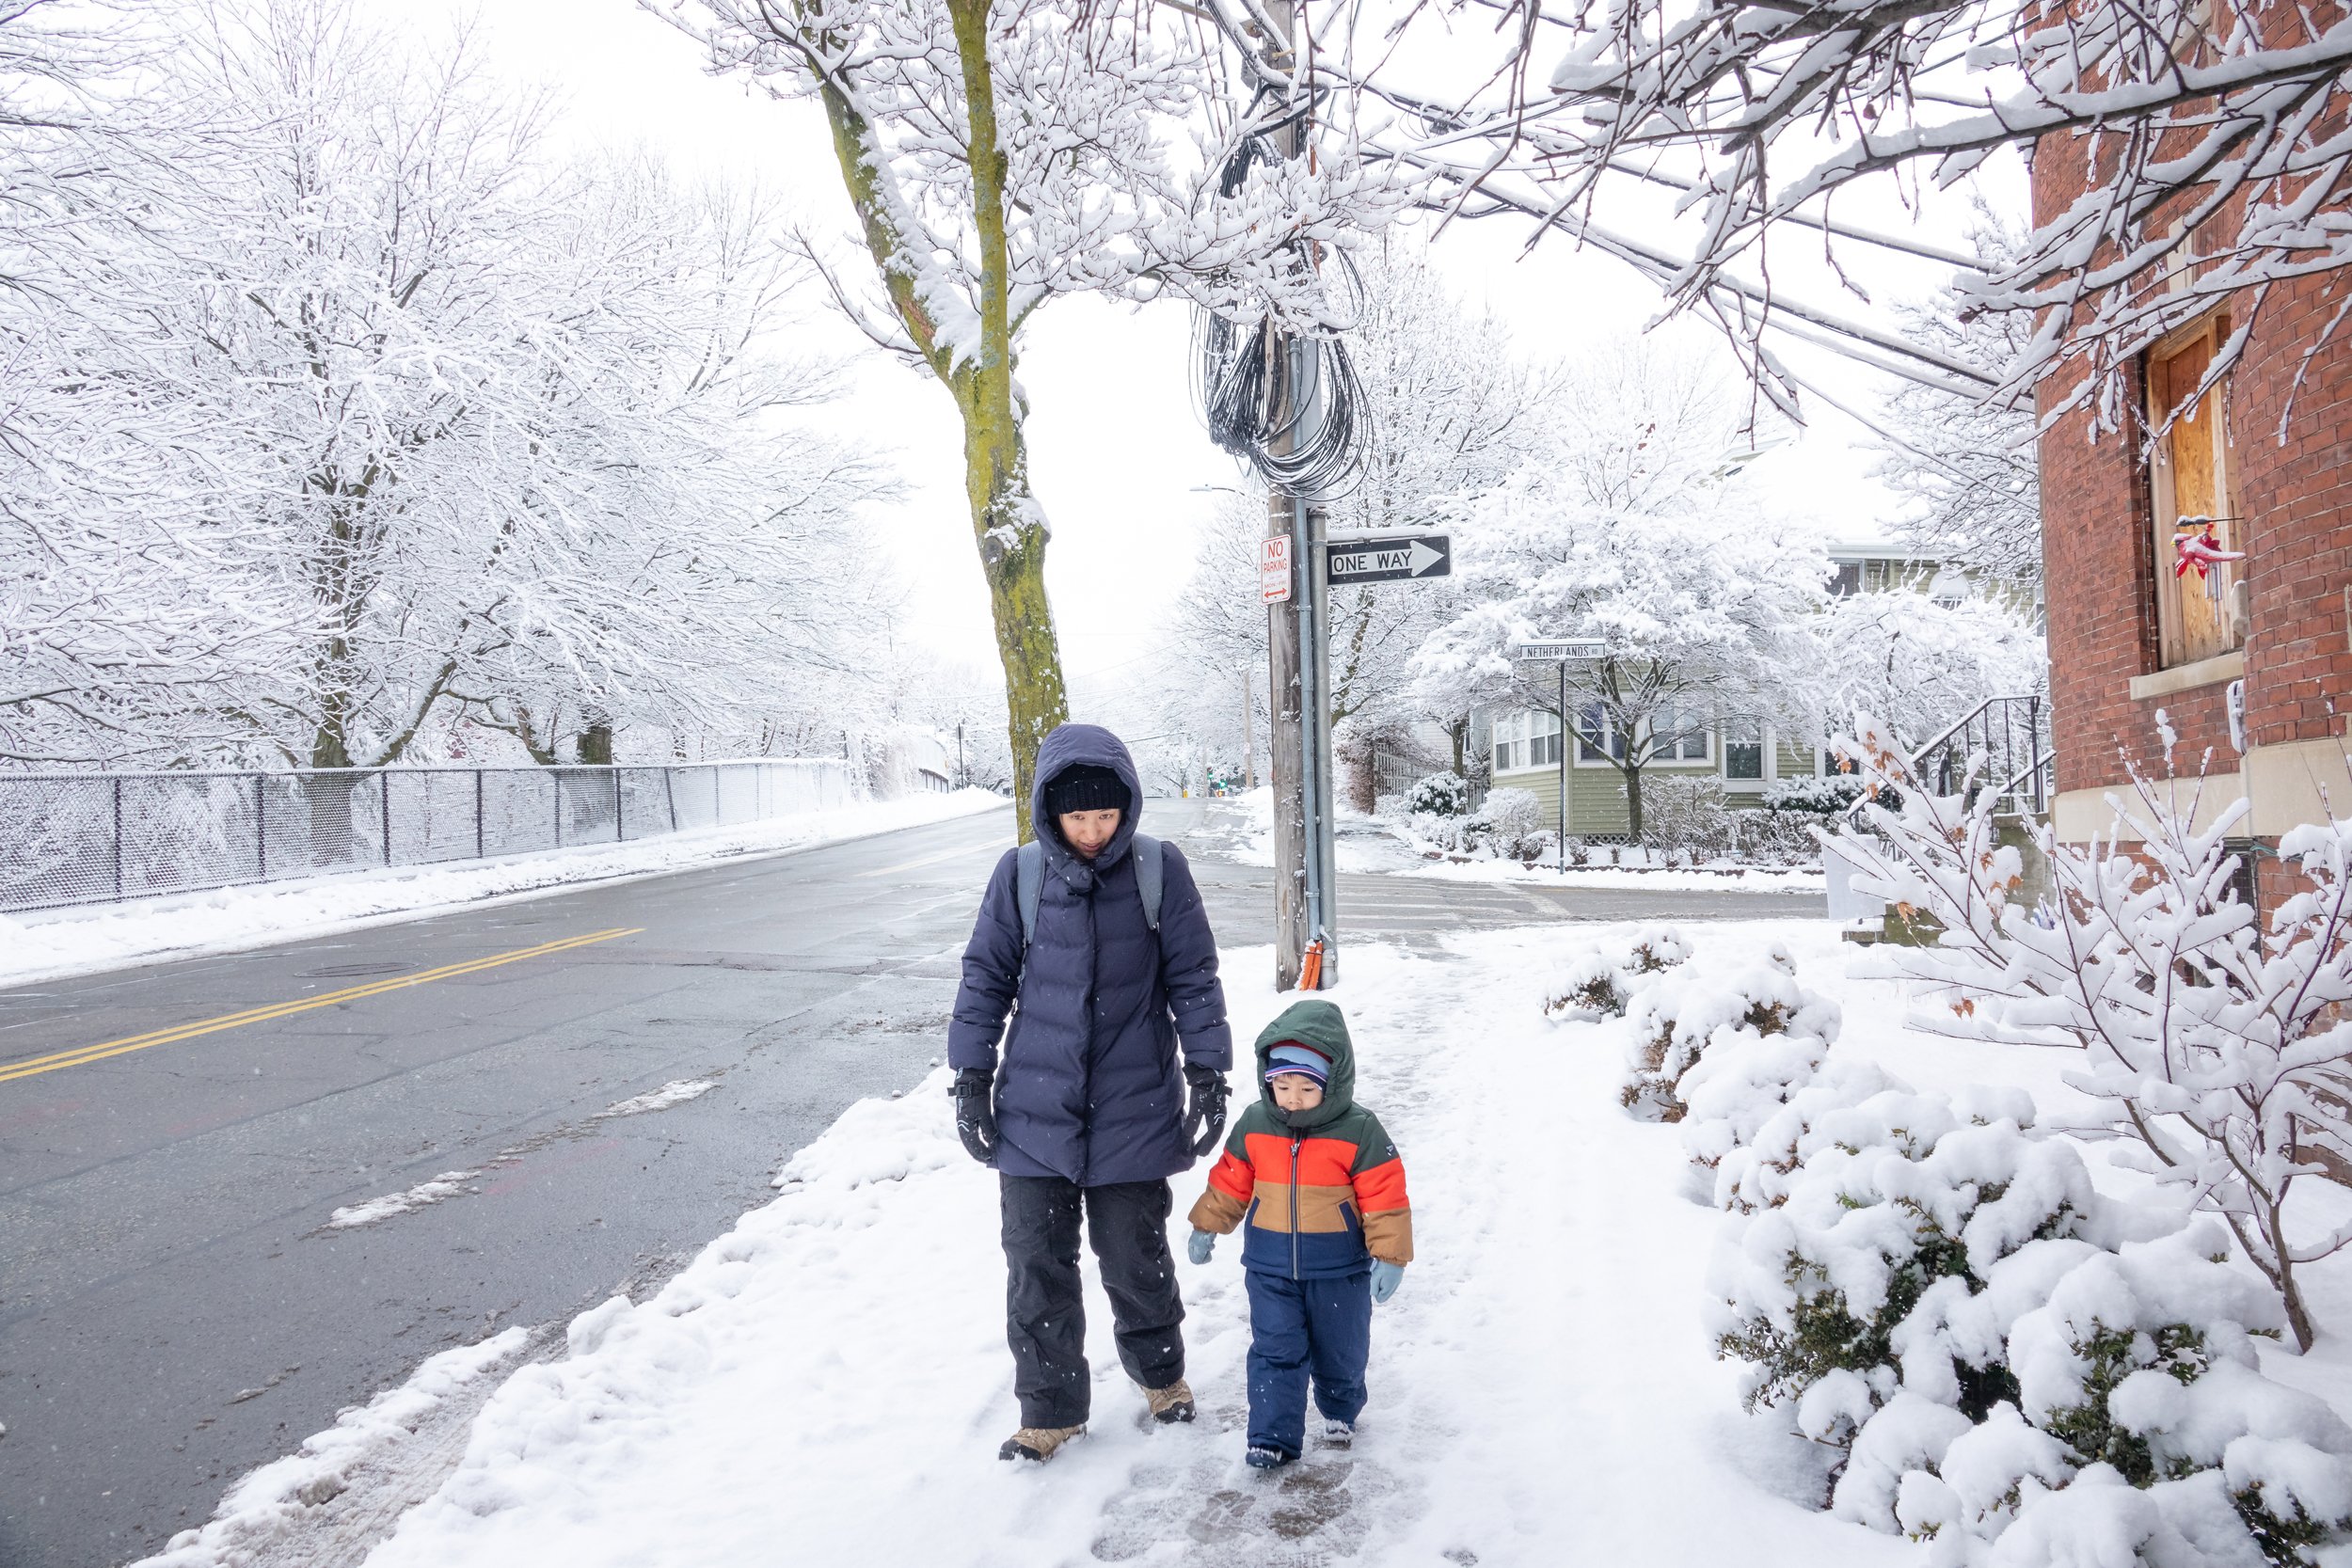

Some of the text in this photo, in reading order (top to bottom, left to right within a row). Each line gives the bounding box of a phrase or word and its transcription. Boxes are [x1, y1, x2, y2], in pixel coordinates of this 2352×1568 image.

[1267, 541, 1283, 559] NO
[1263, 558, 1288, 574] PARKING
[1333, 551, 1412, 572] ONE WAY
